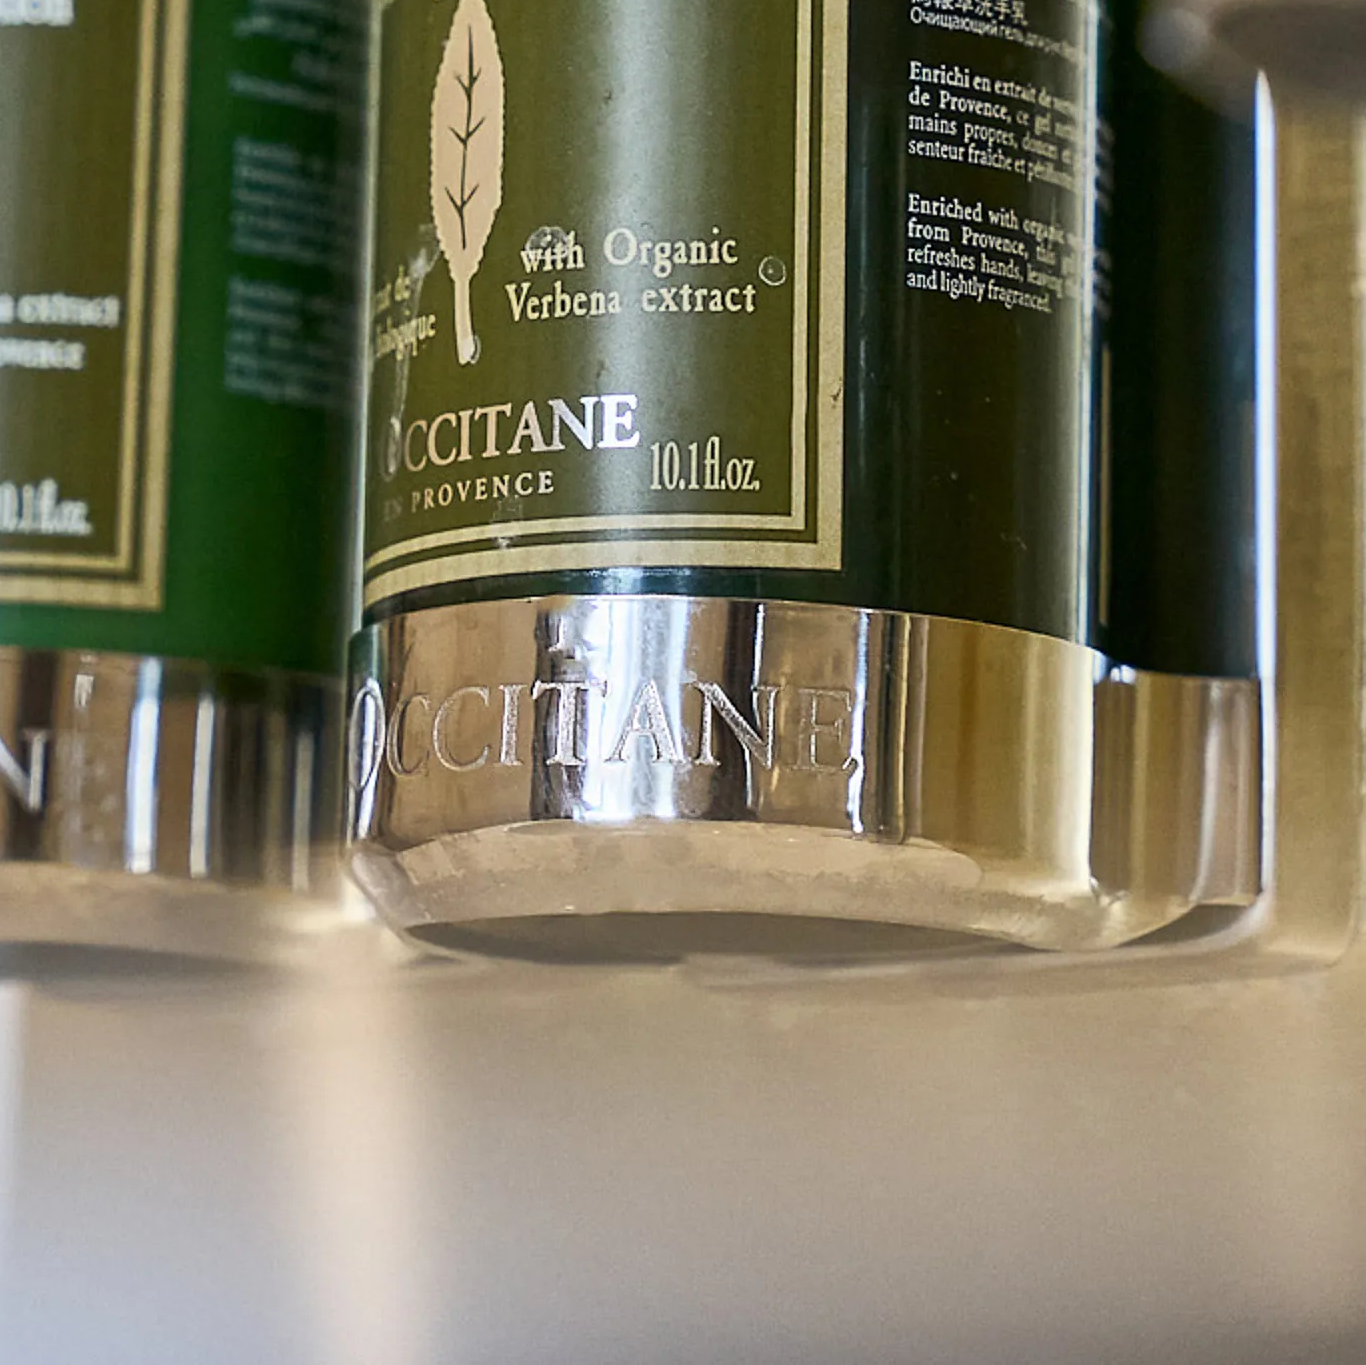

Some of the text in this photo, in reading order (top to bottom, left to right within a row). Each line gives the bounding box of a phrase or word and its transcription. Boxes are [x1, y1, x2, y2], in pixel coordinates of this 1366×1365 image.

[909, 60, 970, 88] Enrichi
[972, 75, 991, 92] en
[995, 80, 1036, 103] extrait
[908, 85, 931, 106] de
[939, 90, 1012, 123] Provence,
[1016, 110, 1030, 126] ce
[908, 113, 958, 135] mains
[964, 122, 1018, 149] propres,
[908, 138, 965, 161] senteur
[1014, 158, 1026, 175] et
[908, 193, 983, 222] Enriched
[988, 208, 1019, 231] with
[521, 226, 738, 278] with Organic
[907, 217, 950, 242] from
[962, 226, 1030, 260] Provence,
[907, 244, 976, 272] refreshes
[980, 253, 1024, 284] hands,
[505, 280, 756, 322] Verbena extract
[906, 270, 938, 291] and
[940, 271, 985, 304] lightly
[988, 279, 1053, 313] fragranced.
[411, 470, 554, 513] PROVENCE
